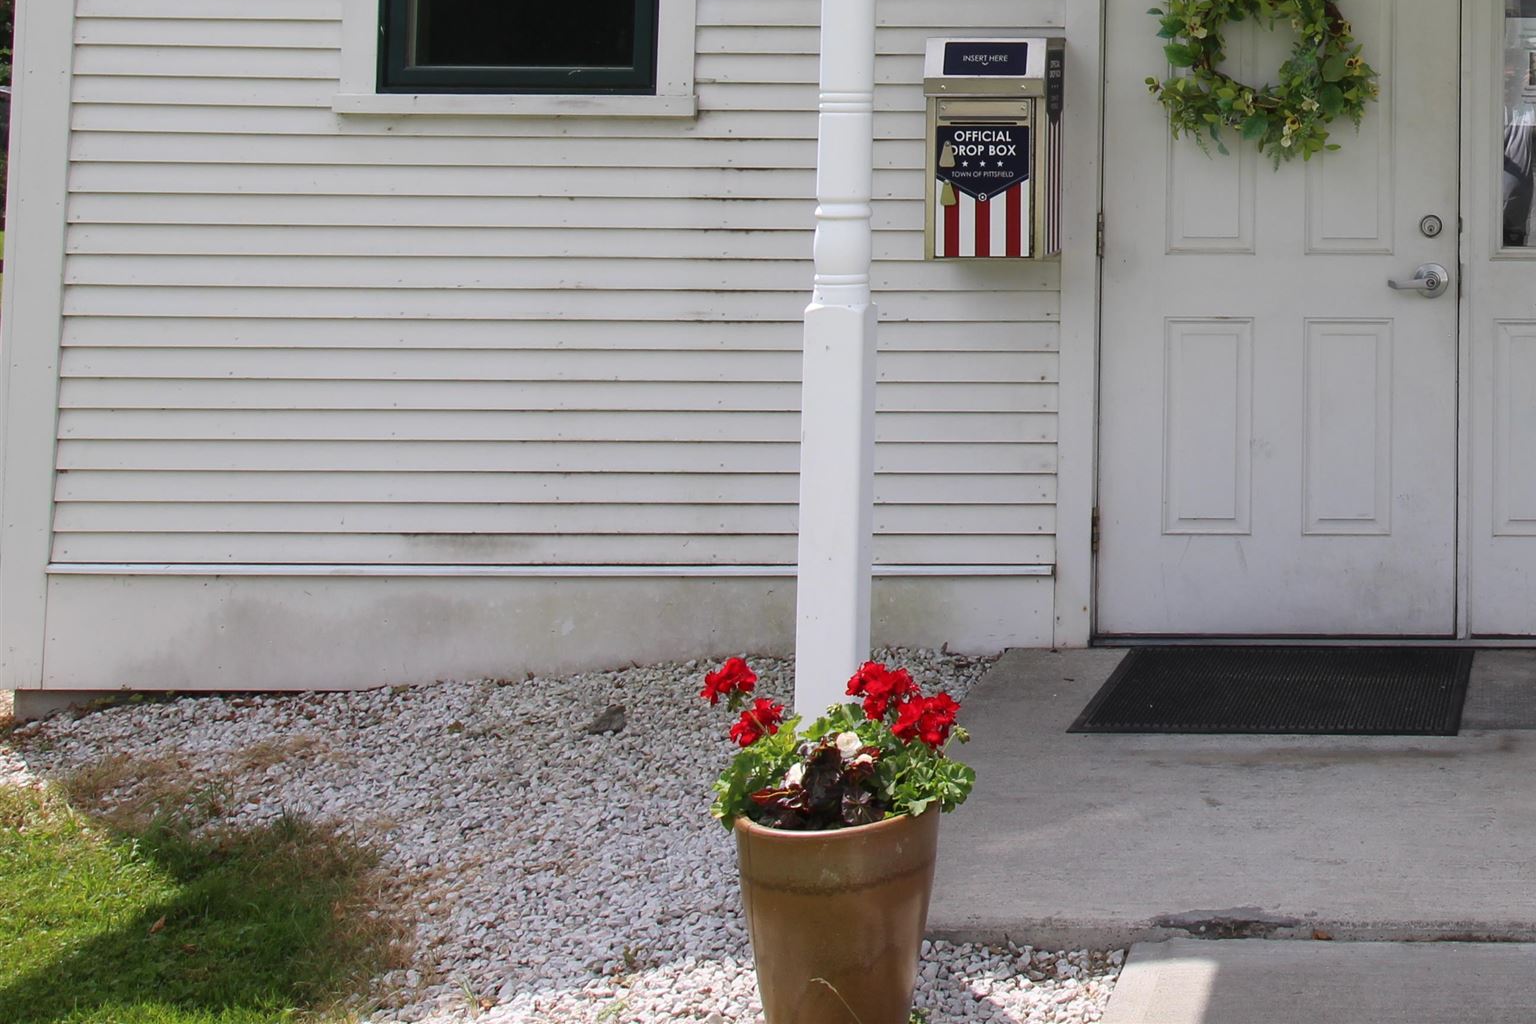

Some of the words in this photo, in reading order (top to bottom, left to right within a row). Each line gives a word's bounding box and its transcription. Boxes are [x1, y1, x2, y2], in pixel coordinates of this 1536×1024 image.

[962, 54, 988, 63] INSERT
[988, 54, 1009, 63] HERE
[954, 130, 1012, 142] OFFICIAL
[951, 144, 985, 156] DROP
[988, 144, 1017, 156] BOX
